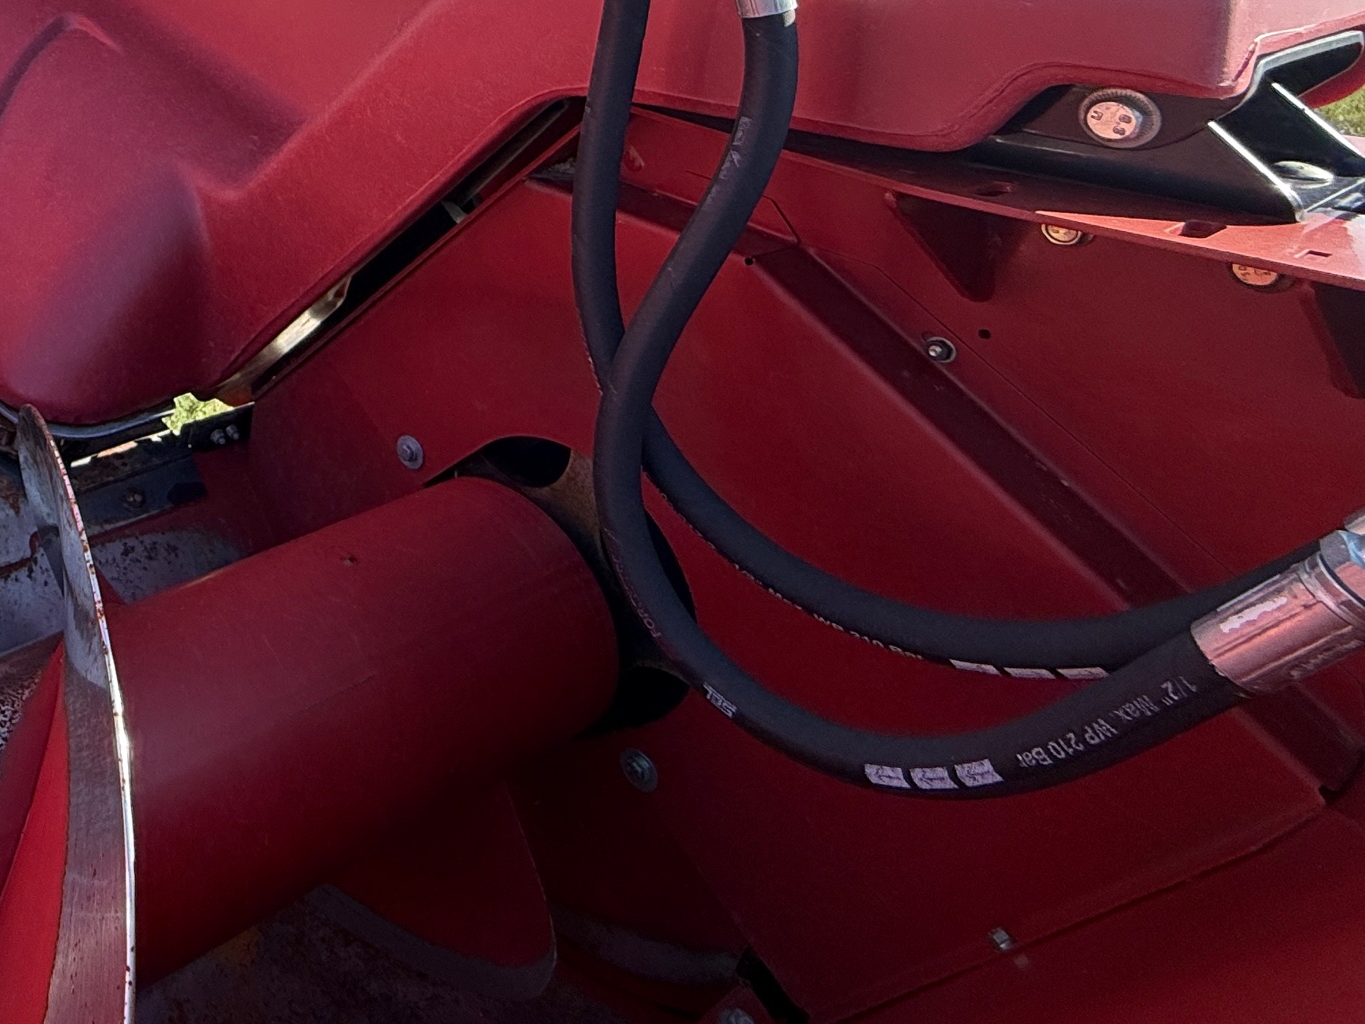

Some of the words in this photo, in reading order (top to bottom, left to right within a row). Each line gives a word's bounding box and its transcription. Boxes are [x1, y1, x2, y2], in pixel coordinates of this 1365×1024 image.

[1113, 114, 1132, 136] 8.8
[1160, 675, 1197, 707] 1/2"
[1083, 717, 1118, 745] WP
[1015, 747, 1054, 767] Bar
[1047, 732, 1084, 759] 210
